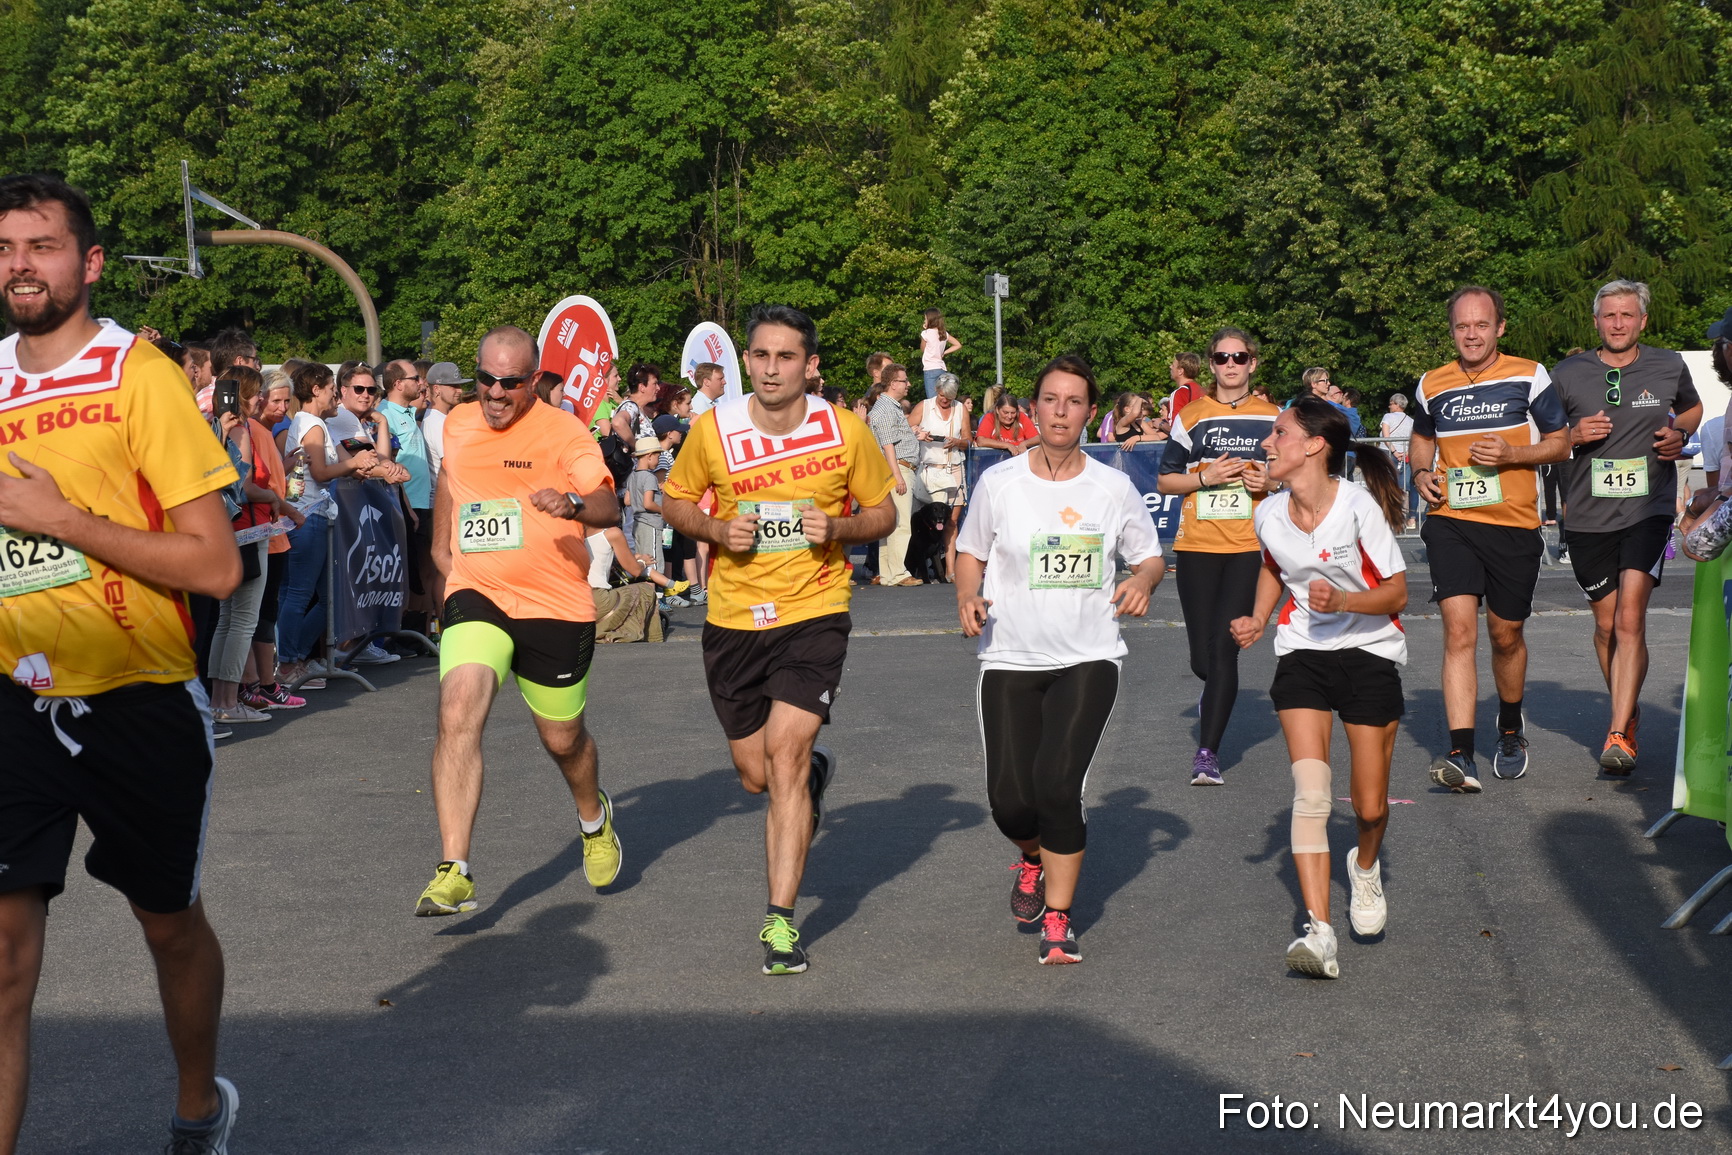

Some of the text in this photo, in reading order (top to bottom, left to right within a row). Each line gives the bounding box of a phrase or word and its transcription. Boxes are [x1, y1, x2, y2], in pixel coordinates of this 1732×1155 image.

[556, 317, 573, 345] AVIA
[1451, 402, 1508, 416] Fischer
[1456, 413, 1504, 422] AUTOMOBILE
[37, 401, 122, 435] BÖGL
[1211, 436, 1258, 446] Fischer
[503, 460, 532, 469] THULE
[731, 455, 847, 496] MAX BÖGL
[1603, 472, 1636, 487] 415
[1455, 480, 1487, 497] 773
[1208, 493, 1239, 508] 752
[463, 517, 510, 539] 2301
[17, 558, 79, 577] Gavril-Augustin
[1040, 553, 1092, 574] 1371
